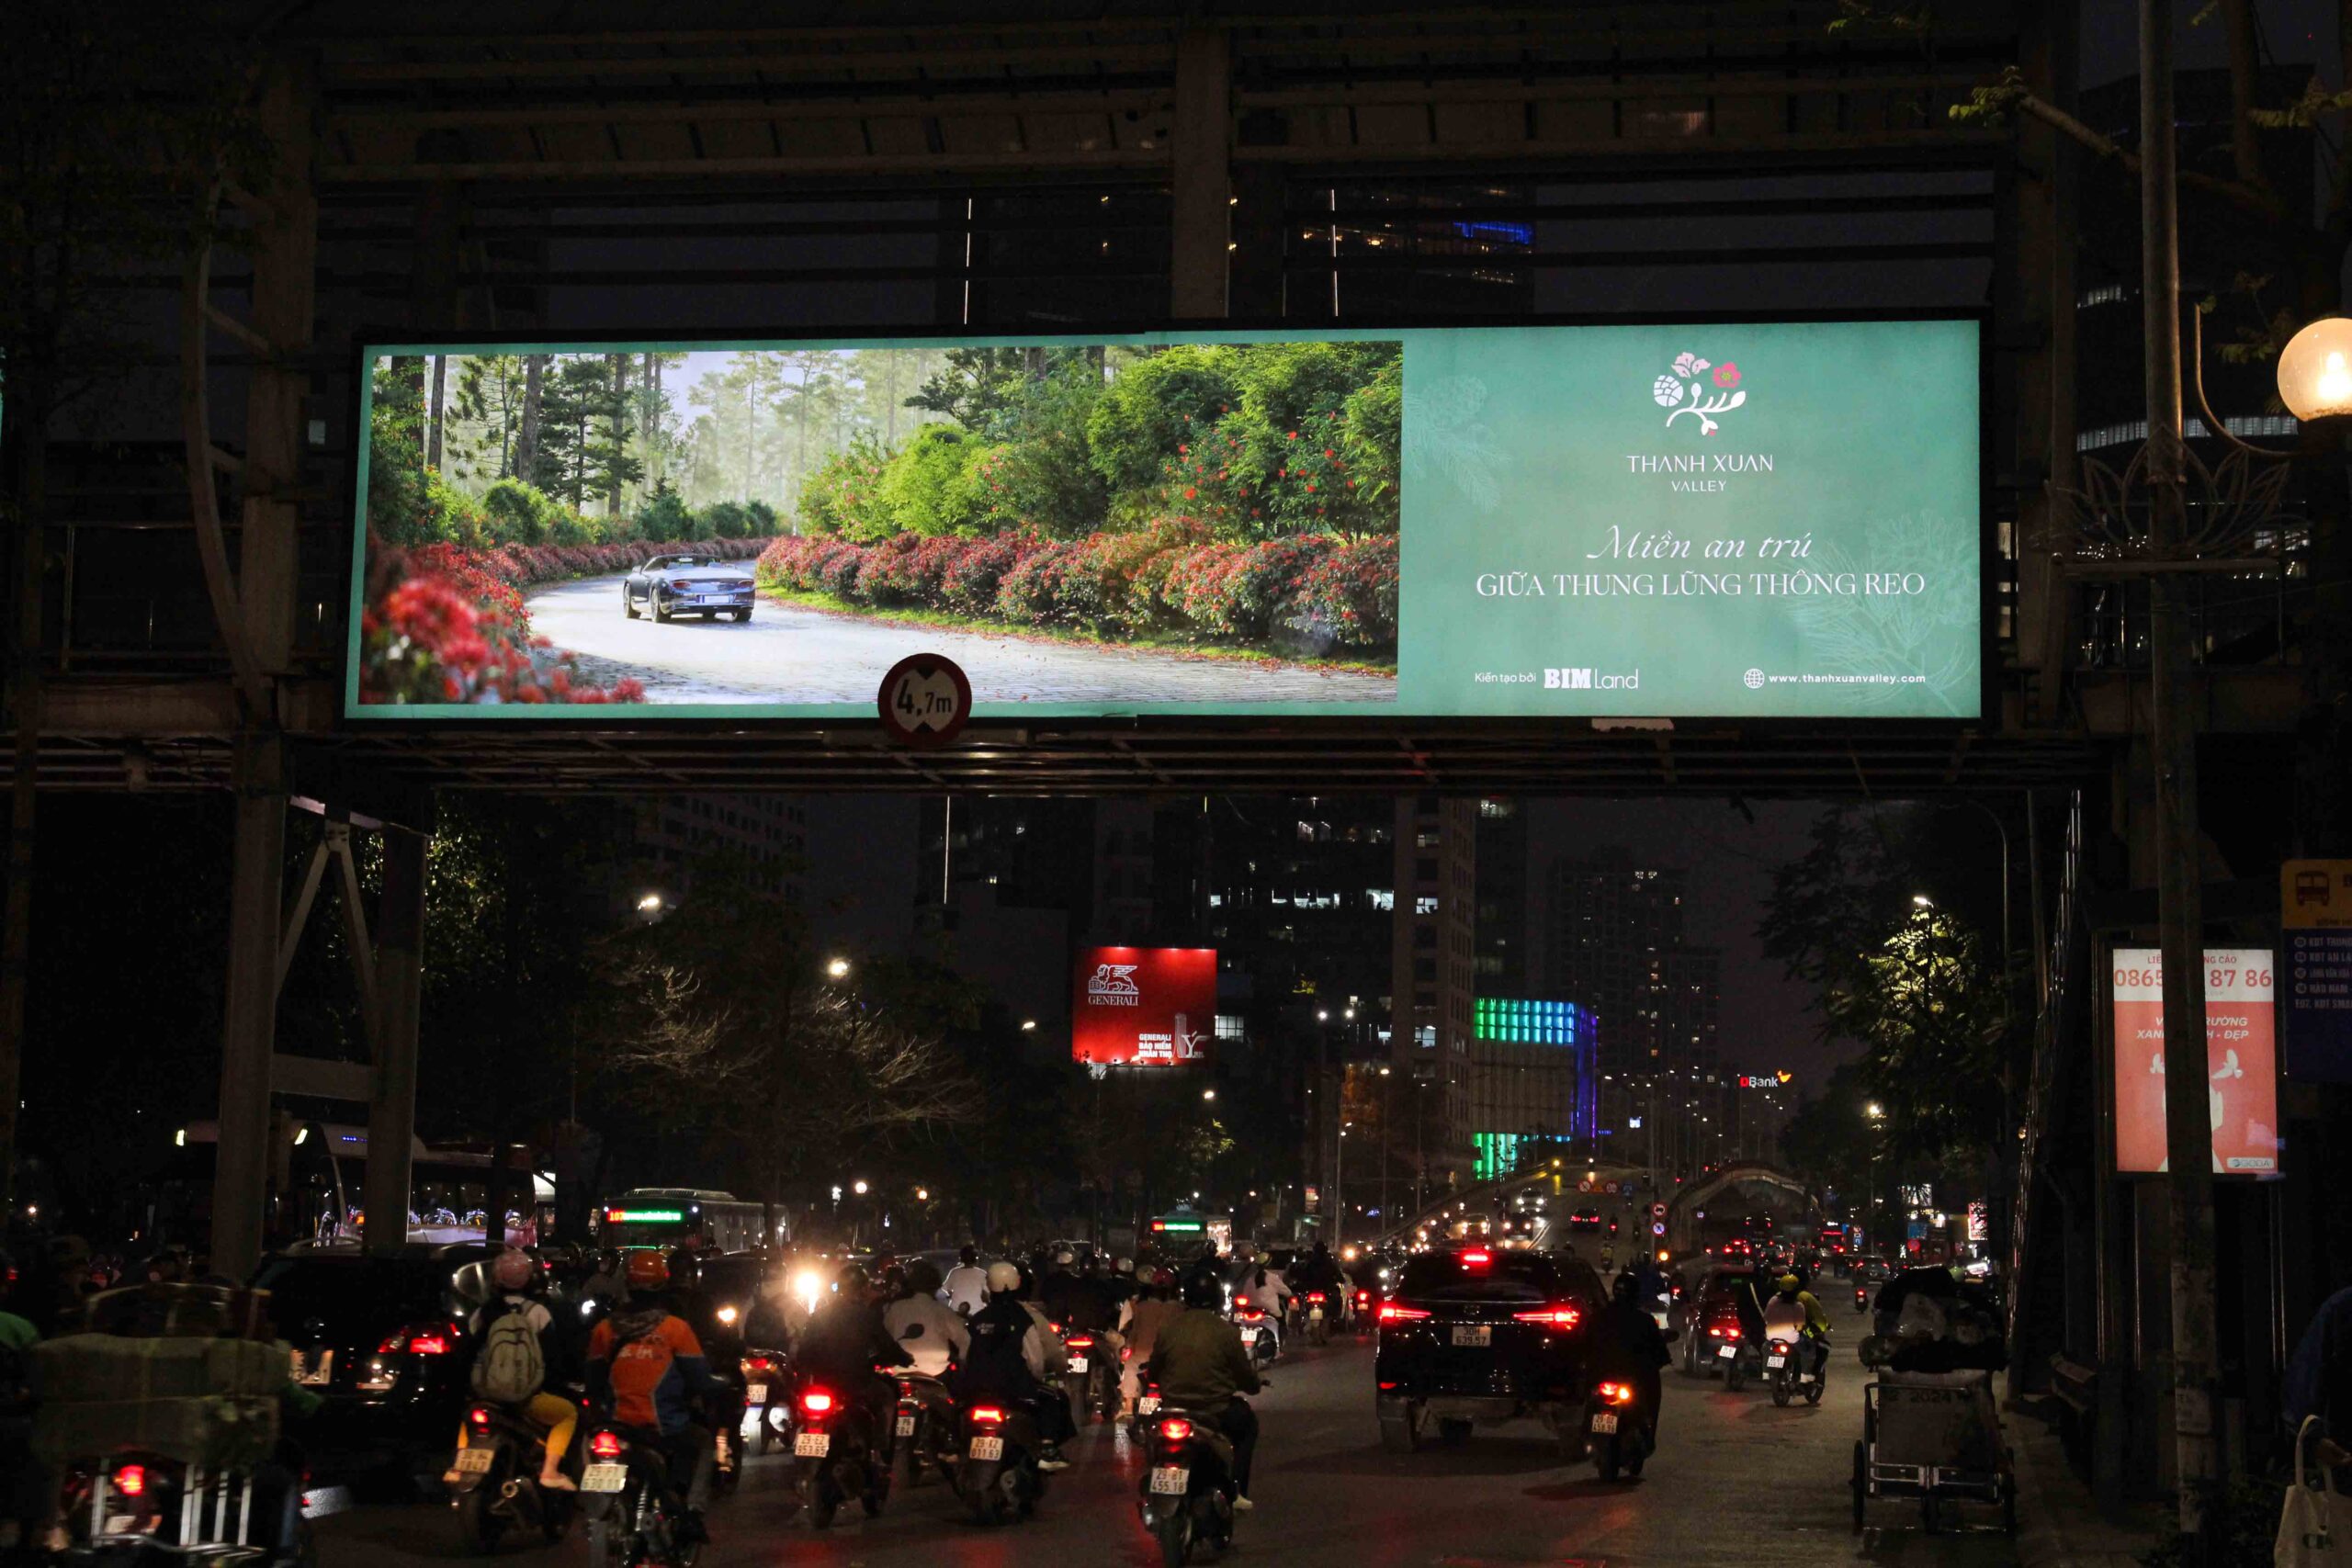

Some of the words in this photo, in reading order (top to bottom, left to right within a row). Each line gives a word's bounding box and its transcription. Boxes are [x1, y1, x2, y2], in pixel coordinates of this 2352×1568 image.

[1626, 455, 1705, 473] THANH
[1713, 454, 1773, 472] XUAN
[1670, 480, 1727, 492] VALLEY
[1586, 525, 1691, 558] Miền
[1704, 539, 1746, 558] an
[1758, 532, 1813, 558] trú
[1476, 571, 1546, 596] GIỮA
[1553, 574, 1655, 596] THUNG
[1661, 570, 1742, 596] LŨNG
[1748, 569, 1856, 595] THÔNG
[1865, 572, 1926, 595] REO
[1475, 671, 1498, 683] Kiến
[1499, 672, 1517, 684] tạo
[1519, 671, 1537, 683] bởi
[1544, 668, 1592, 690] BIM
[1594, 669, 1639, 690] Land
[1769, 673, 1927, 685] www.thanhxuanvalley.com
[2218, 954, 2238, 964] CÁO
[2210, 969, 2236, 987] 87
[2245, 969, 2272, 988] 86
[1088, 995, 1139, 1007] GENERALI
